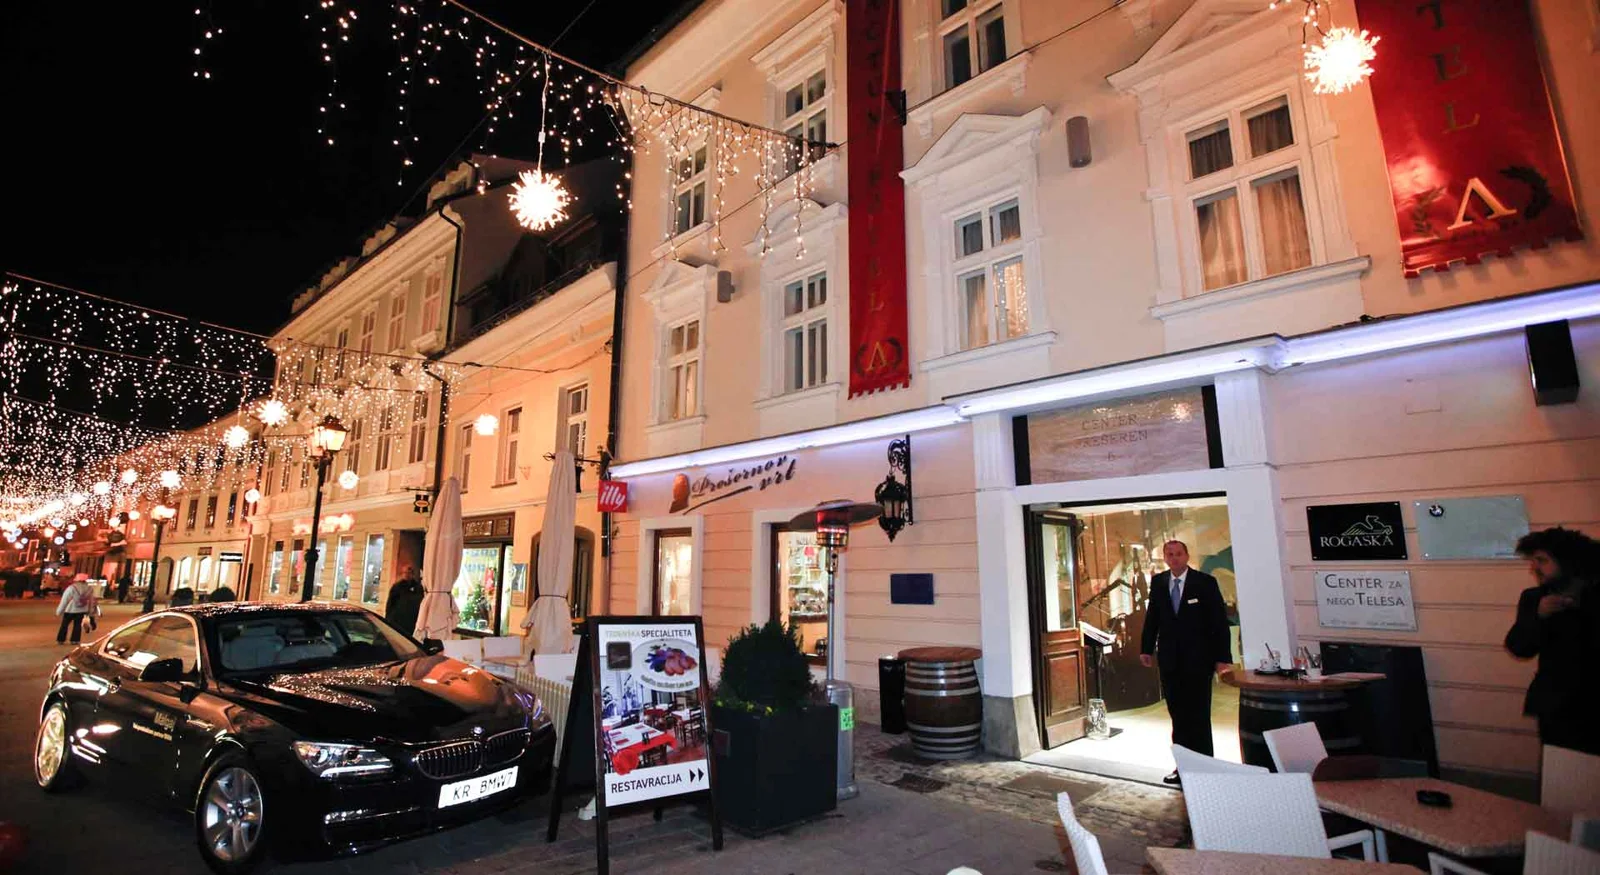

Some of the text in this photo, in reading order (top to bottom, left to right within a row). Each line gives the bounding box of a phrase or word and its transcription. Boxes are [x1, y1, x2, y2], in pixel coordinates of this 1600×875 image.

[760, 459, 797, 491] vrt
[600, 482, 627, 508] illy
[641, 629, 692, 638] SPECIALITETA
[453, 784, 471, 801] KR
[611, 773, 682, 794] RESTAVRACIJA
